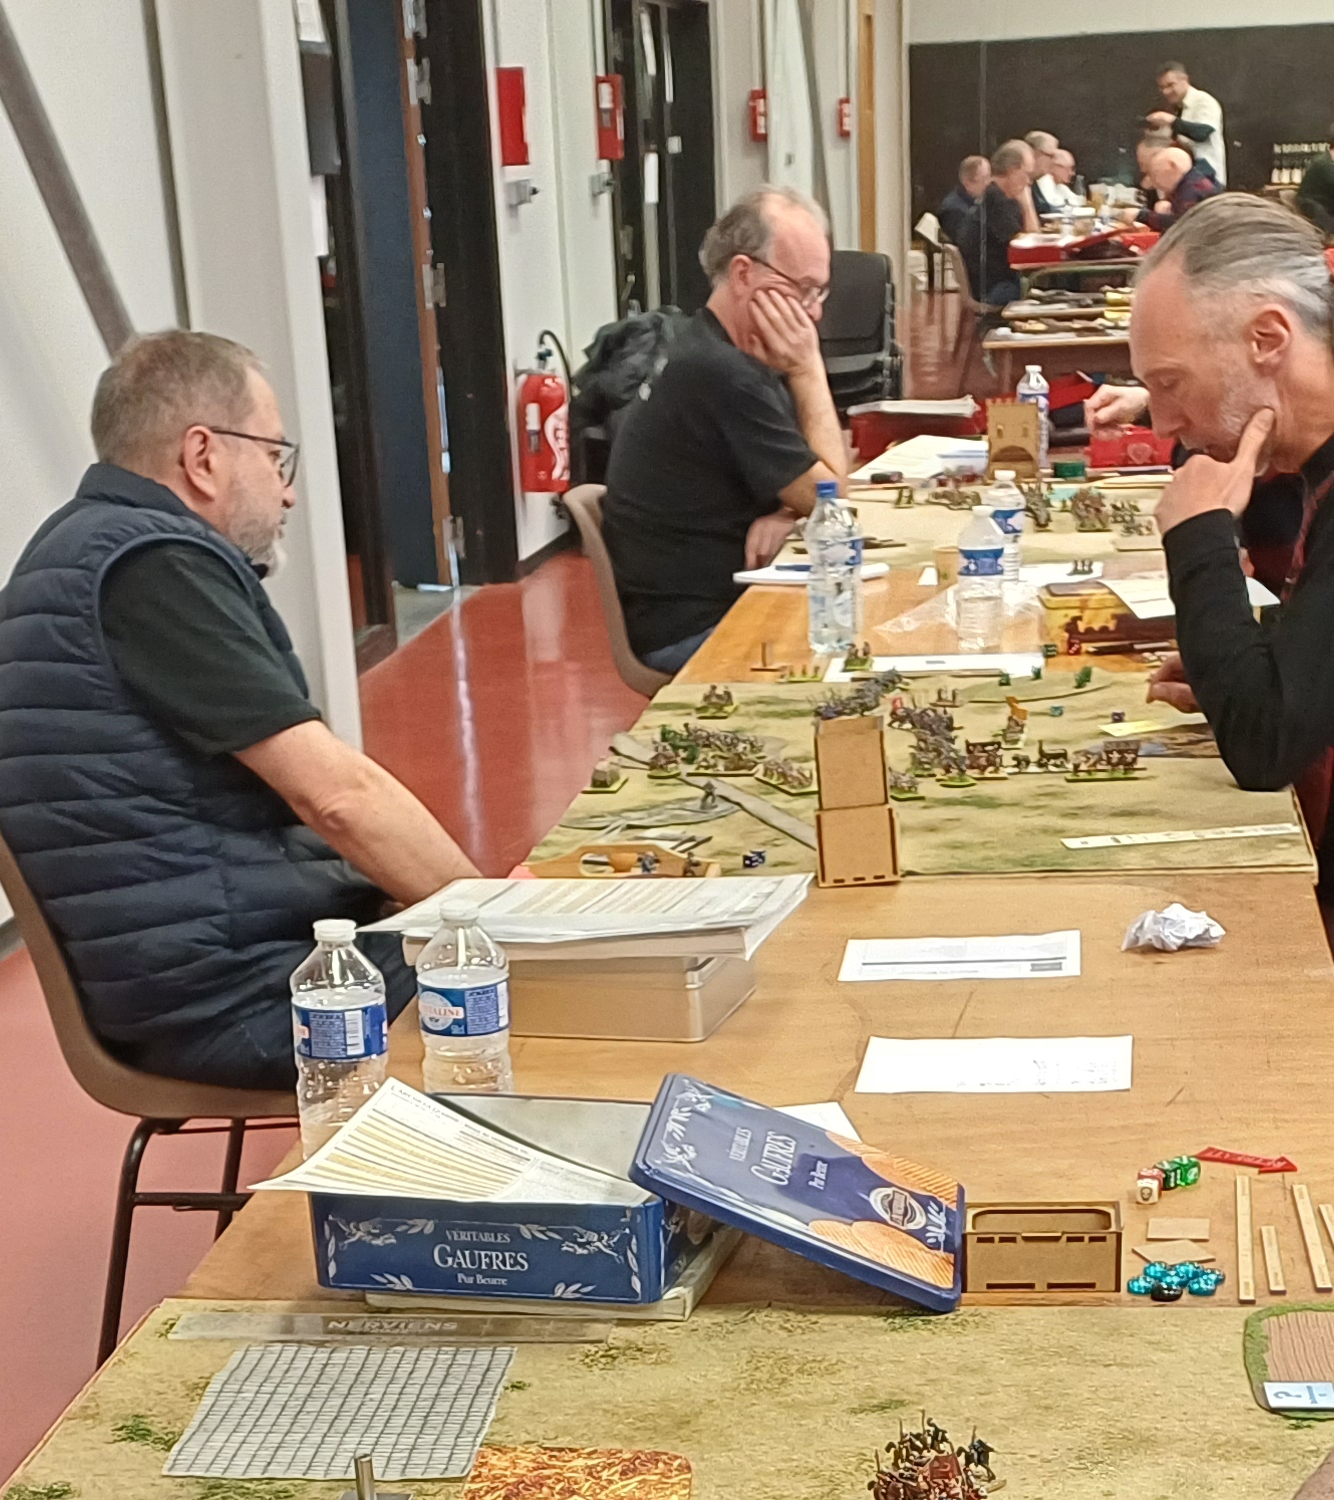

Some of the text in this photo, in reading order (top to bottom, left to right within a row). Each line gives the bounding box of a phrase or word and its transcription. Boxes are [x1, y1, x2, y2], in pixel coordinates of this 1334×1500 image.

[433, 1243, 529, 1272] GAUFRES
[456, 1273, 508, 1286] Pur Beurre
